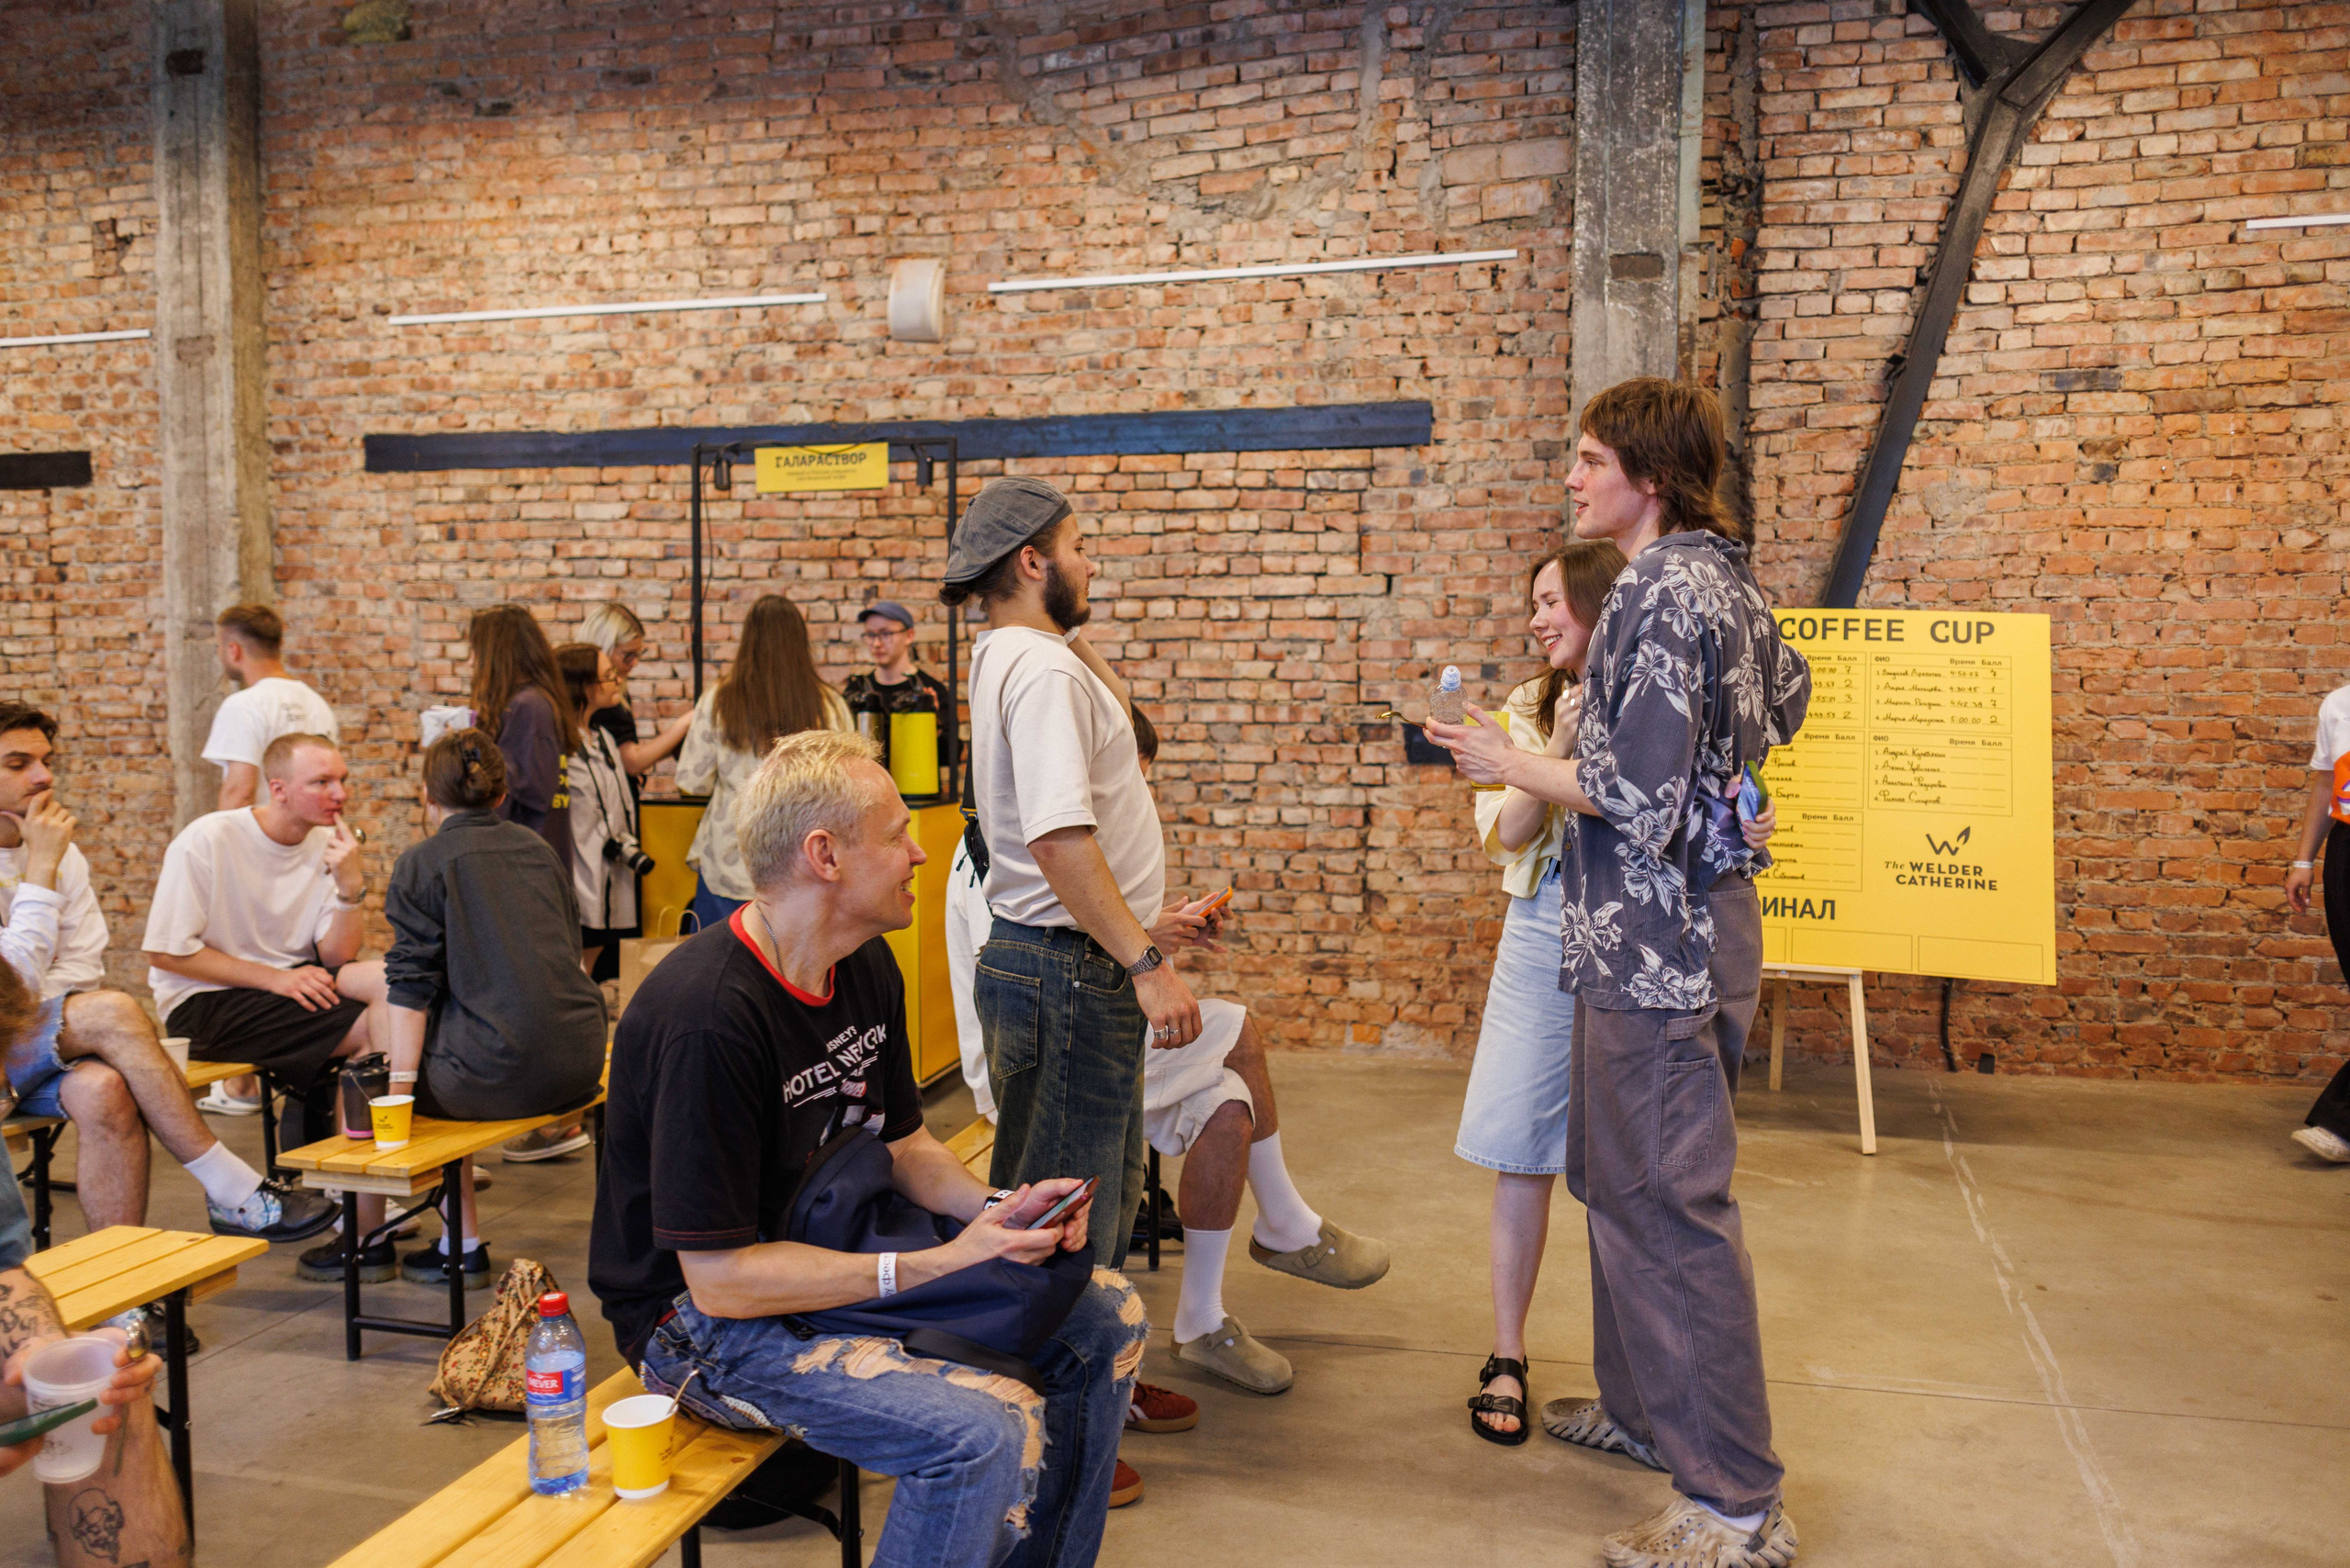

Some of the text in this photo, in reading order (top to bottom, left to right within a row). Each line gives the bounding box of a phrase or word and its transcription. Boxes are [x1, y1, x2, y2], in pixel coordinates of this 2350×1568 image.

[1778, 618, 1995, 644] COFFEE CUP
[1802, 812, 1828, 821] Время
[1885, 860, 1983, 877] The WELDER
[1896, 874, 1998, 890] CATHERINE
[1762, 896, 1836, 920] ИНАЛ
[782, 1060, 842, 1103] HOTEL
